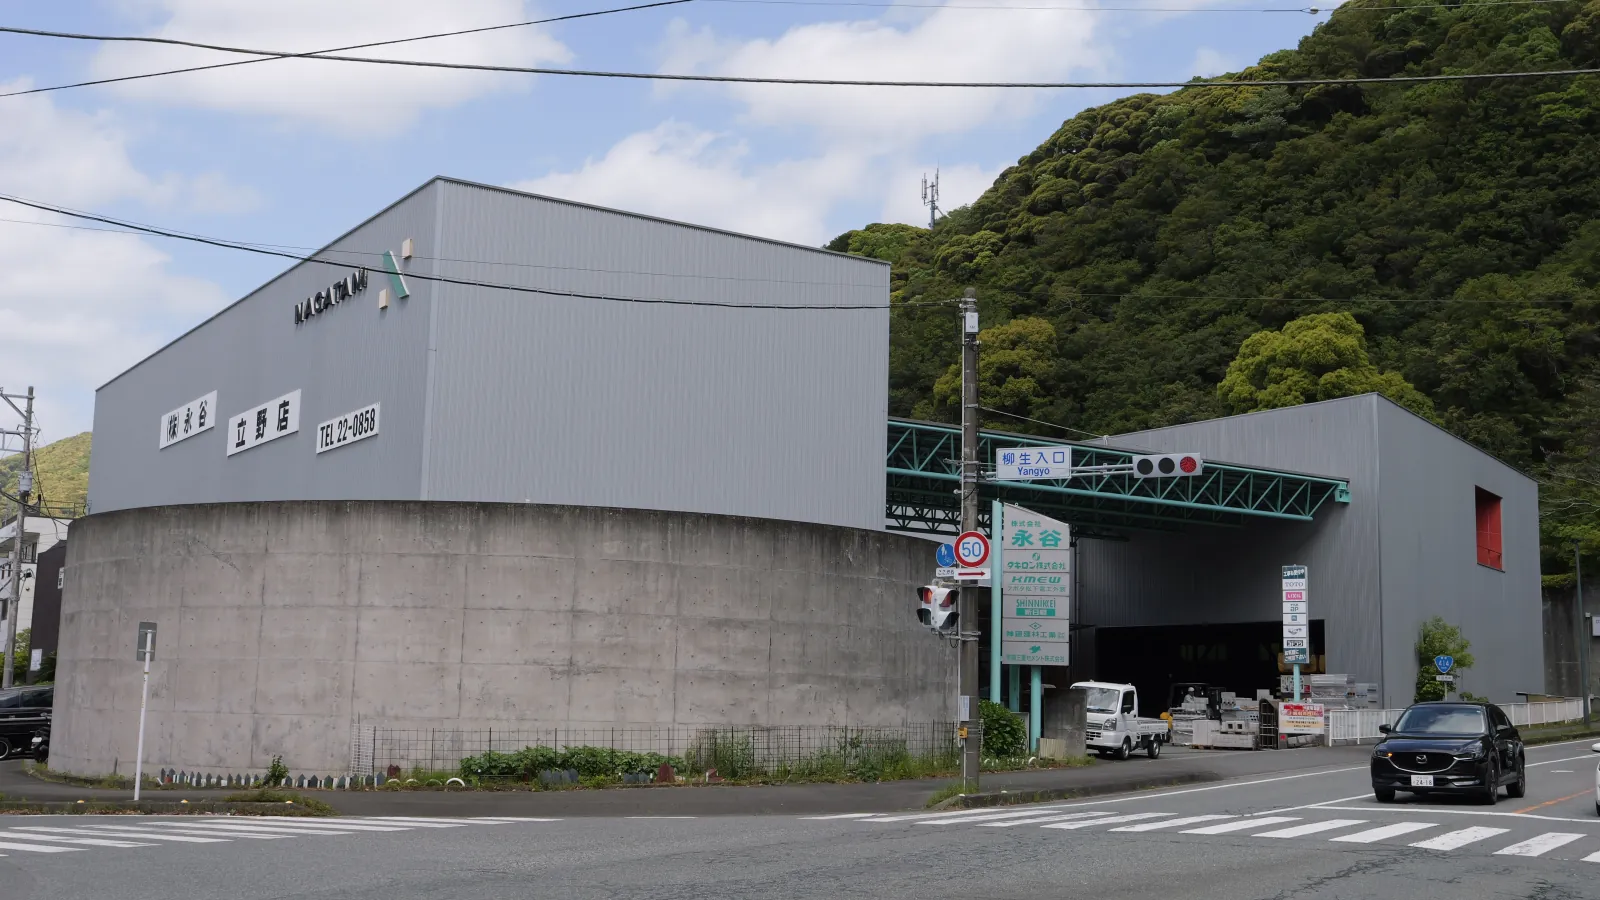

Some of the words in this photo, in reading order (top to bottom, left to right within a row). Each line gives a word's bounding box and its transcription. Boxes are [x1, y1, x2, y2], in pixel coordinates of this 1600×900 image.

[294, 266, 368, 324] NAGATANI
[235, 400, 290, 449] 立野店
[319, 422, 335, 449] TEL
[337, 407, 376, 443] 22-0858
[1002, 451, 1065, 466] 柳生入口
[1011, 520, 1041, 528] 株式会社
[1011, 529, 1062, 548] 永谷
[961, 541, 982, 558] 50
[1007, 561, 1066, 570] タキロン株式会社
